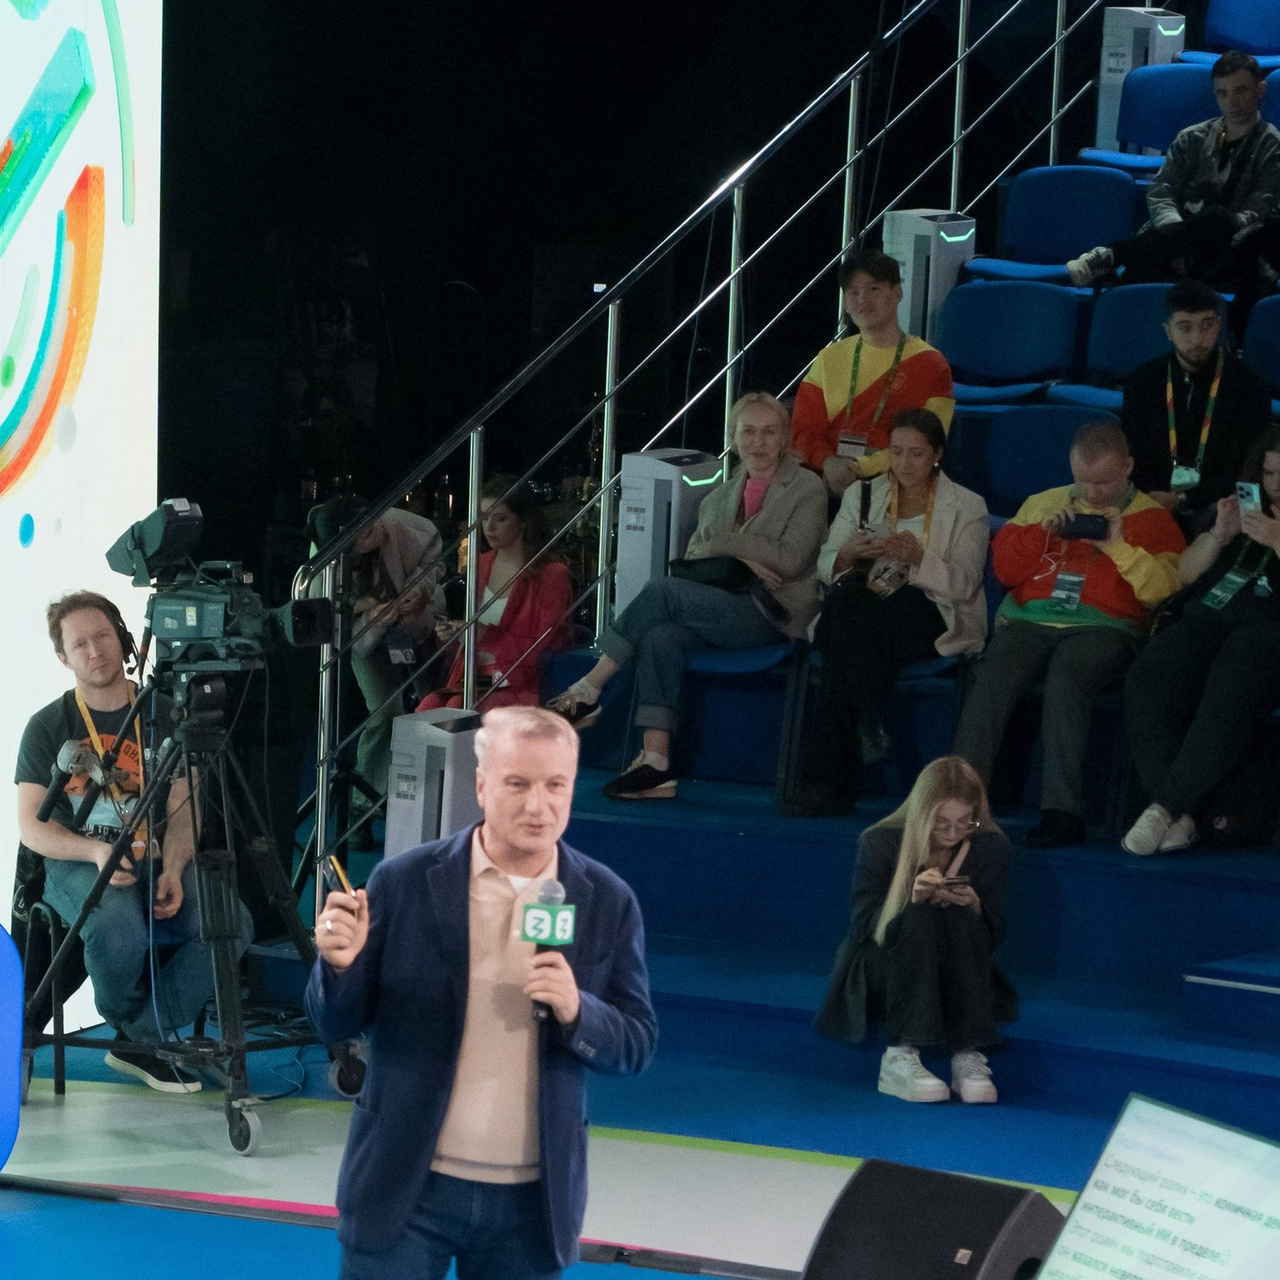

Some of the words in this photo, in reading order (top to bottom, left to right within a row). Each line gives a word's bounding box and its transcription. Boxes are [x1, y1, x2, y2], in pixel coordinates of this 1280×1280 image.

[1079, 1197, 1156, 1240] интерактивный
[1154, 1226, 1172, 1242] ИИ
[1091, 1177, 1111, 1192] как
[1109, 1184, 1130, 1200] мог
[1128, 1189, 1146, 1206] бы
[1143, 1194, 1170, 1215] себя
[1166, 1206, 1196, 1226] вести
[1070, 1250, 1109, 1273] казался
